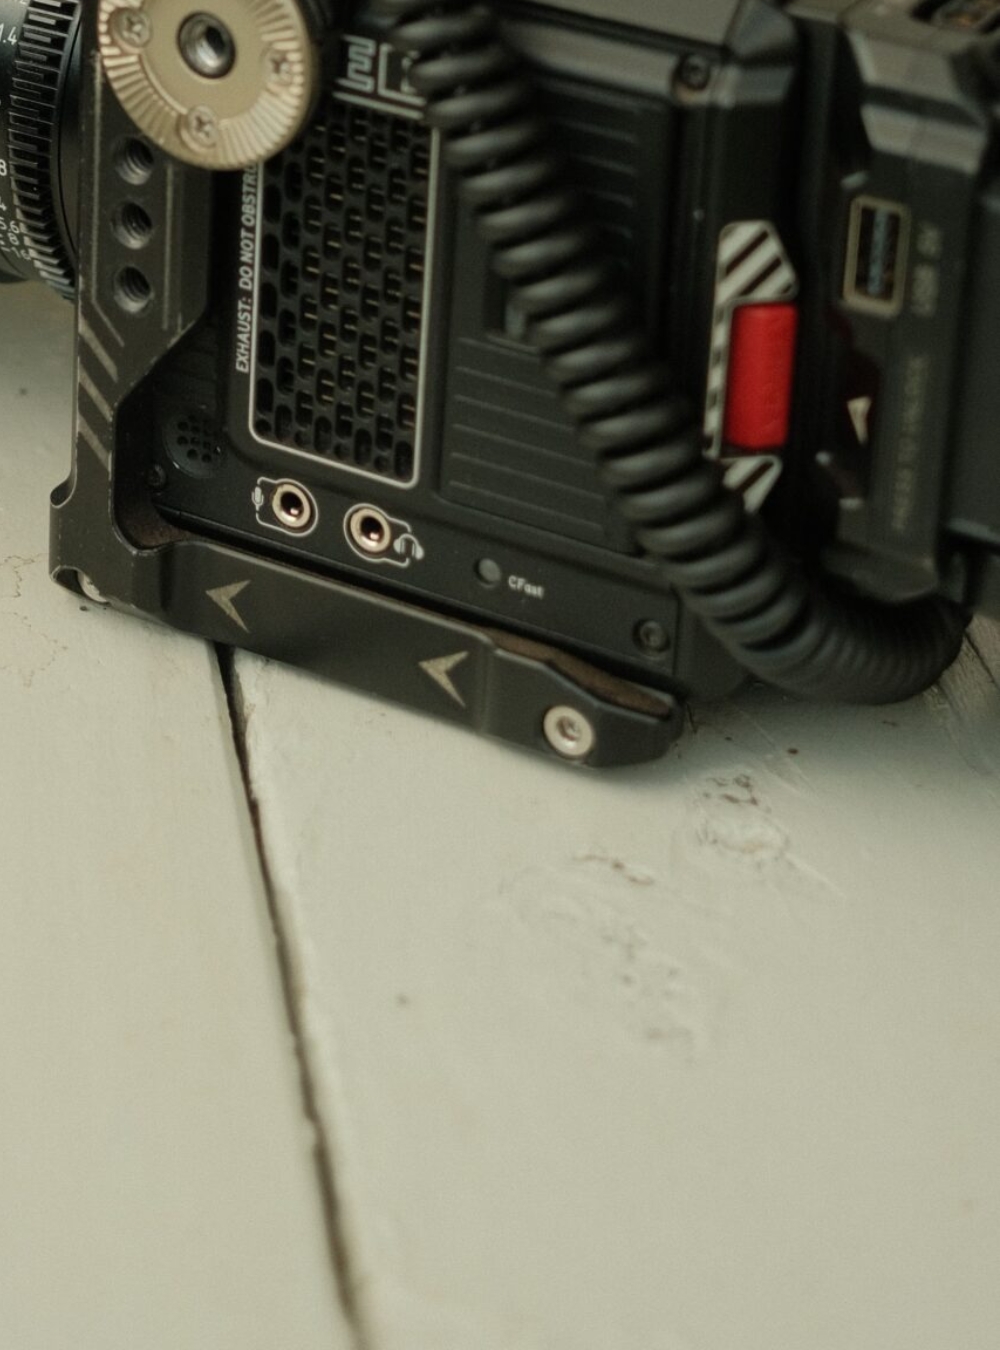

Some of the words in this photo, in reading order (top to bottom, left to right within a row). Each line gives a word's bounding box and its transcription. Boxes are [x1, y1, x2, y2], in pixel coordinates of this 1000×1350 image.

[241, 164, 257, 226] OBSTRU
[240, 228, 255, 263] NOT
[239, 267, 253, 290] DO
[236, 298, 251, 373] EXHAUST:
